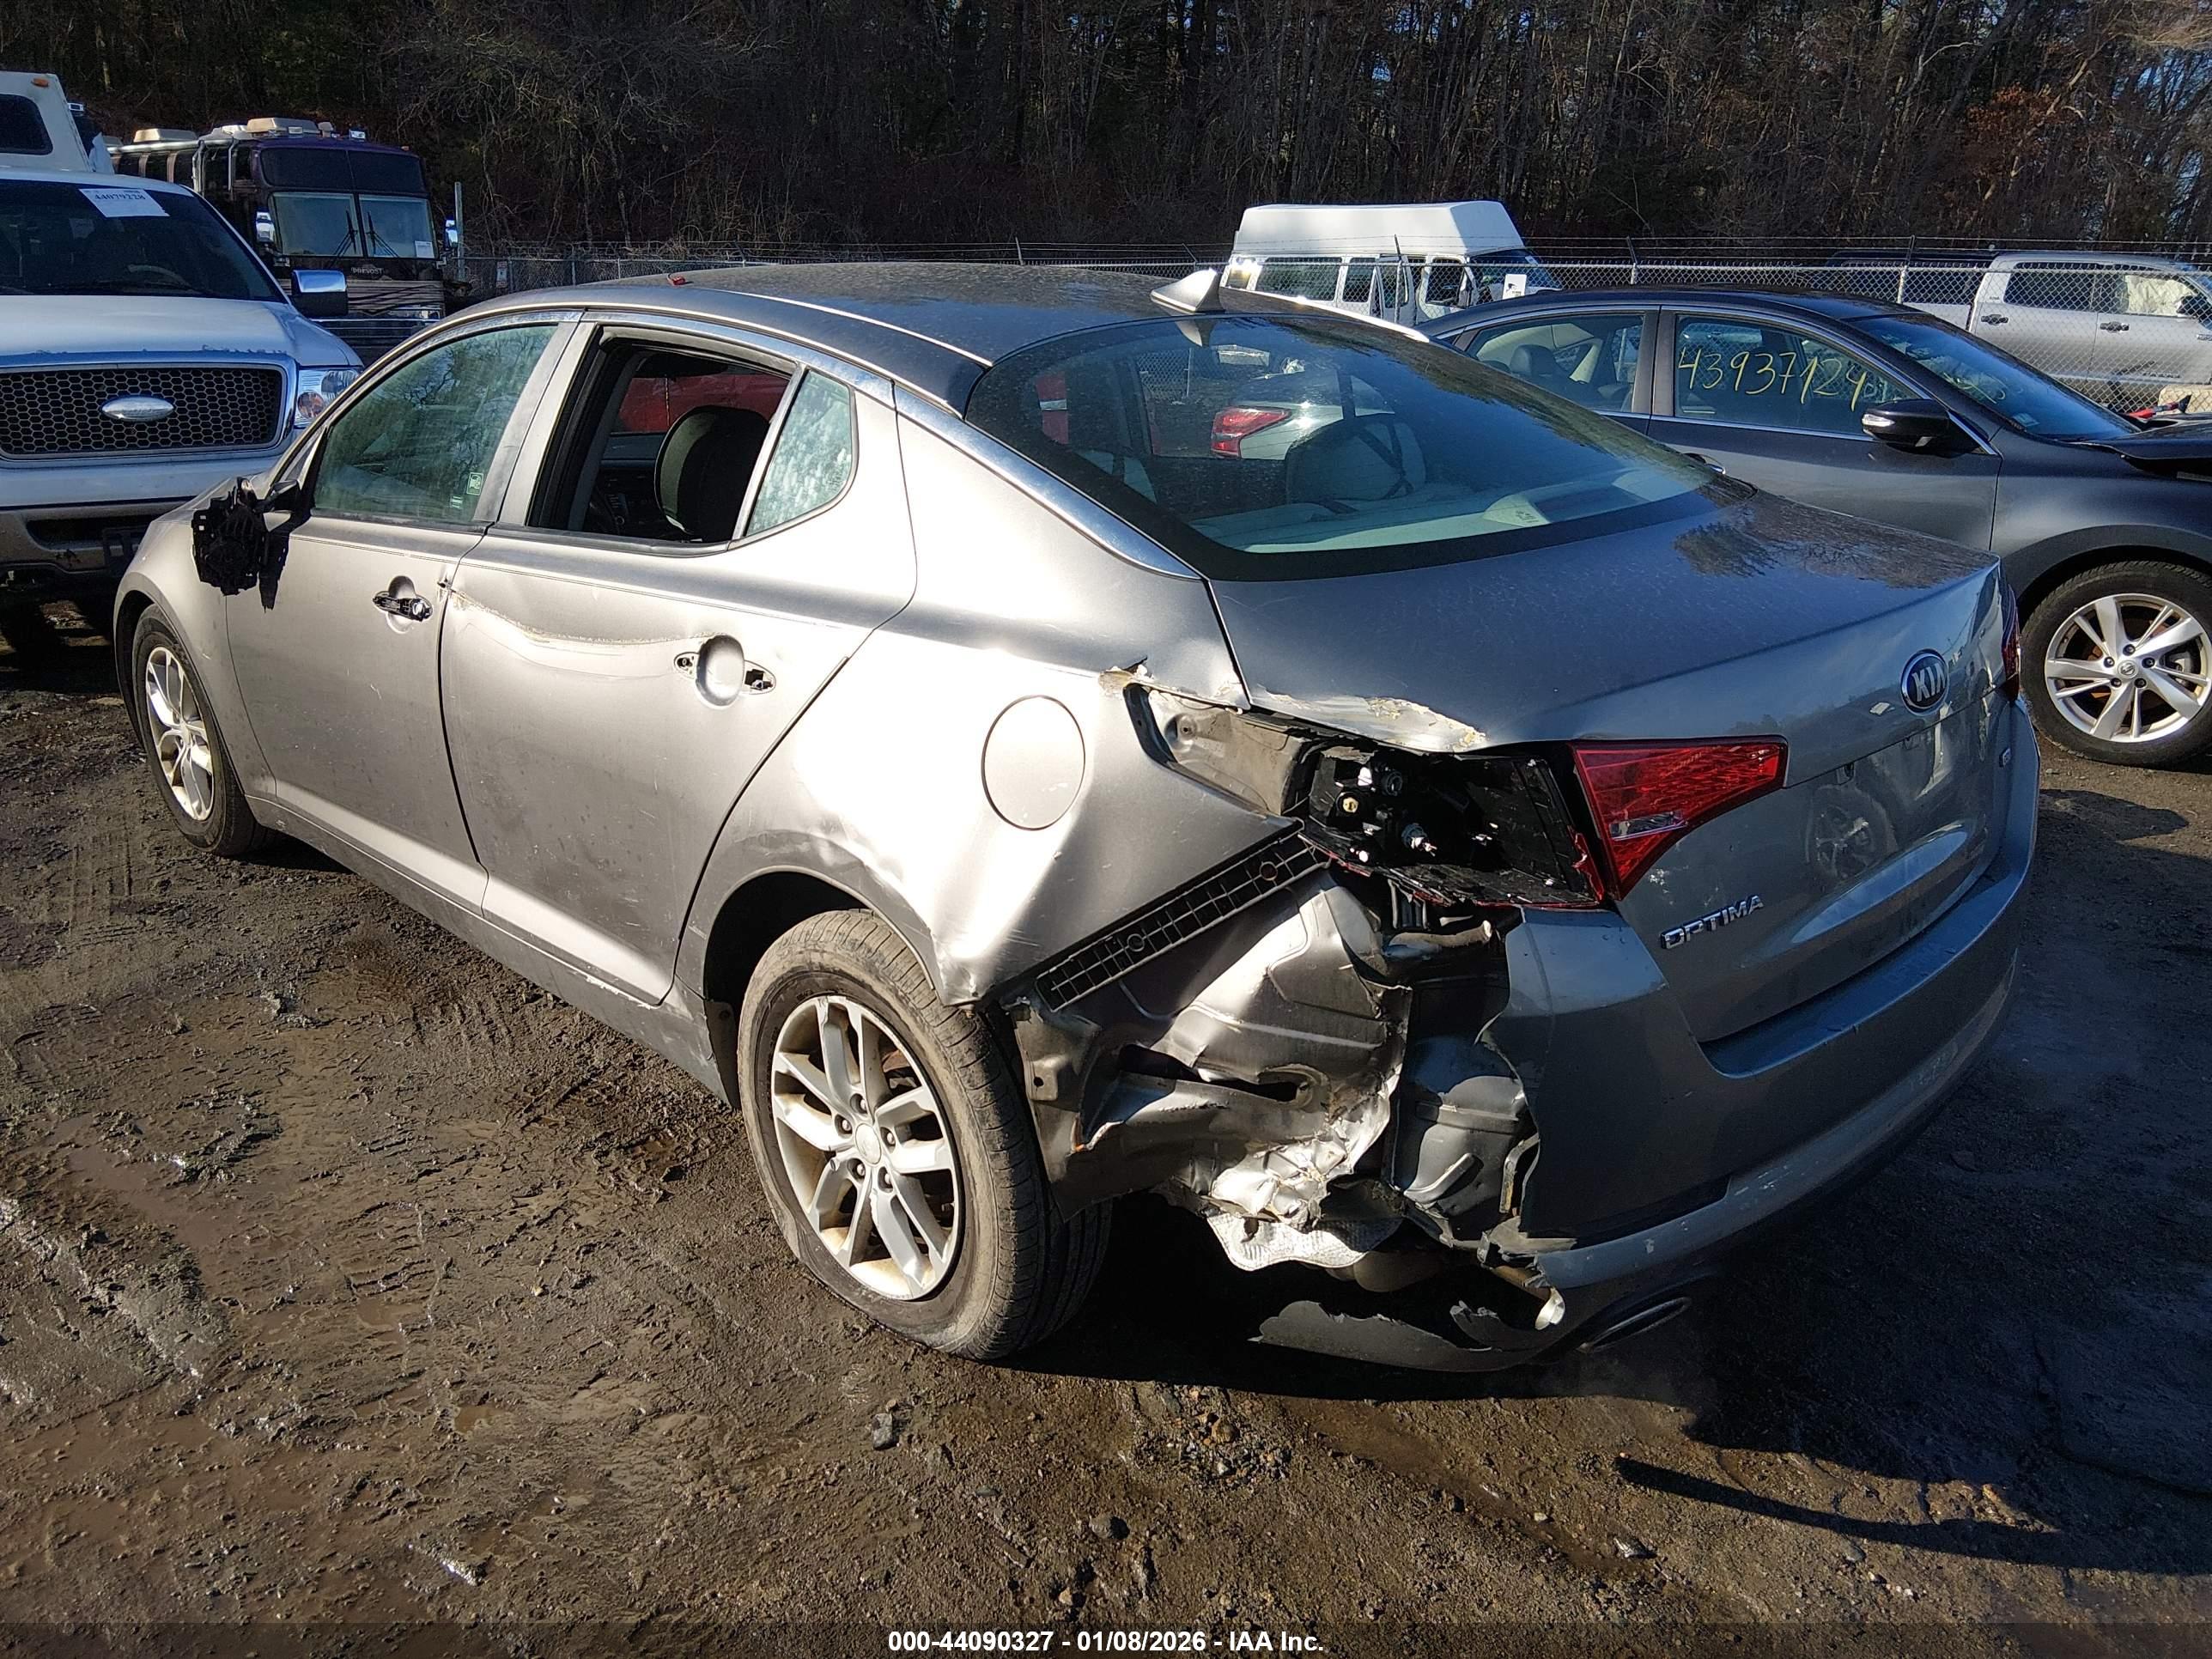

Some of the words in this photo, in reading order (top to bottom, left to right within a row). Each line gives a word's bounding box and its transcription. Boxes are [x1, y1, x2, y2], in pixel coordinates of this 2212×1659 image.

[1678, 345, 1868, 412] 43937124
[1911, 662, 1946, 702] KIA
[1661, 894, 1765, 950] OPTIMA
